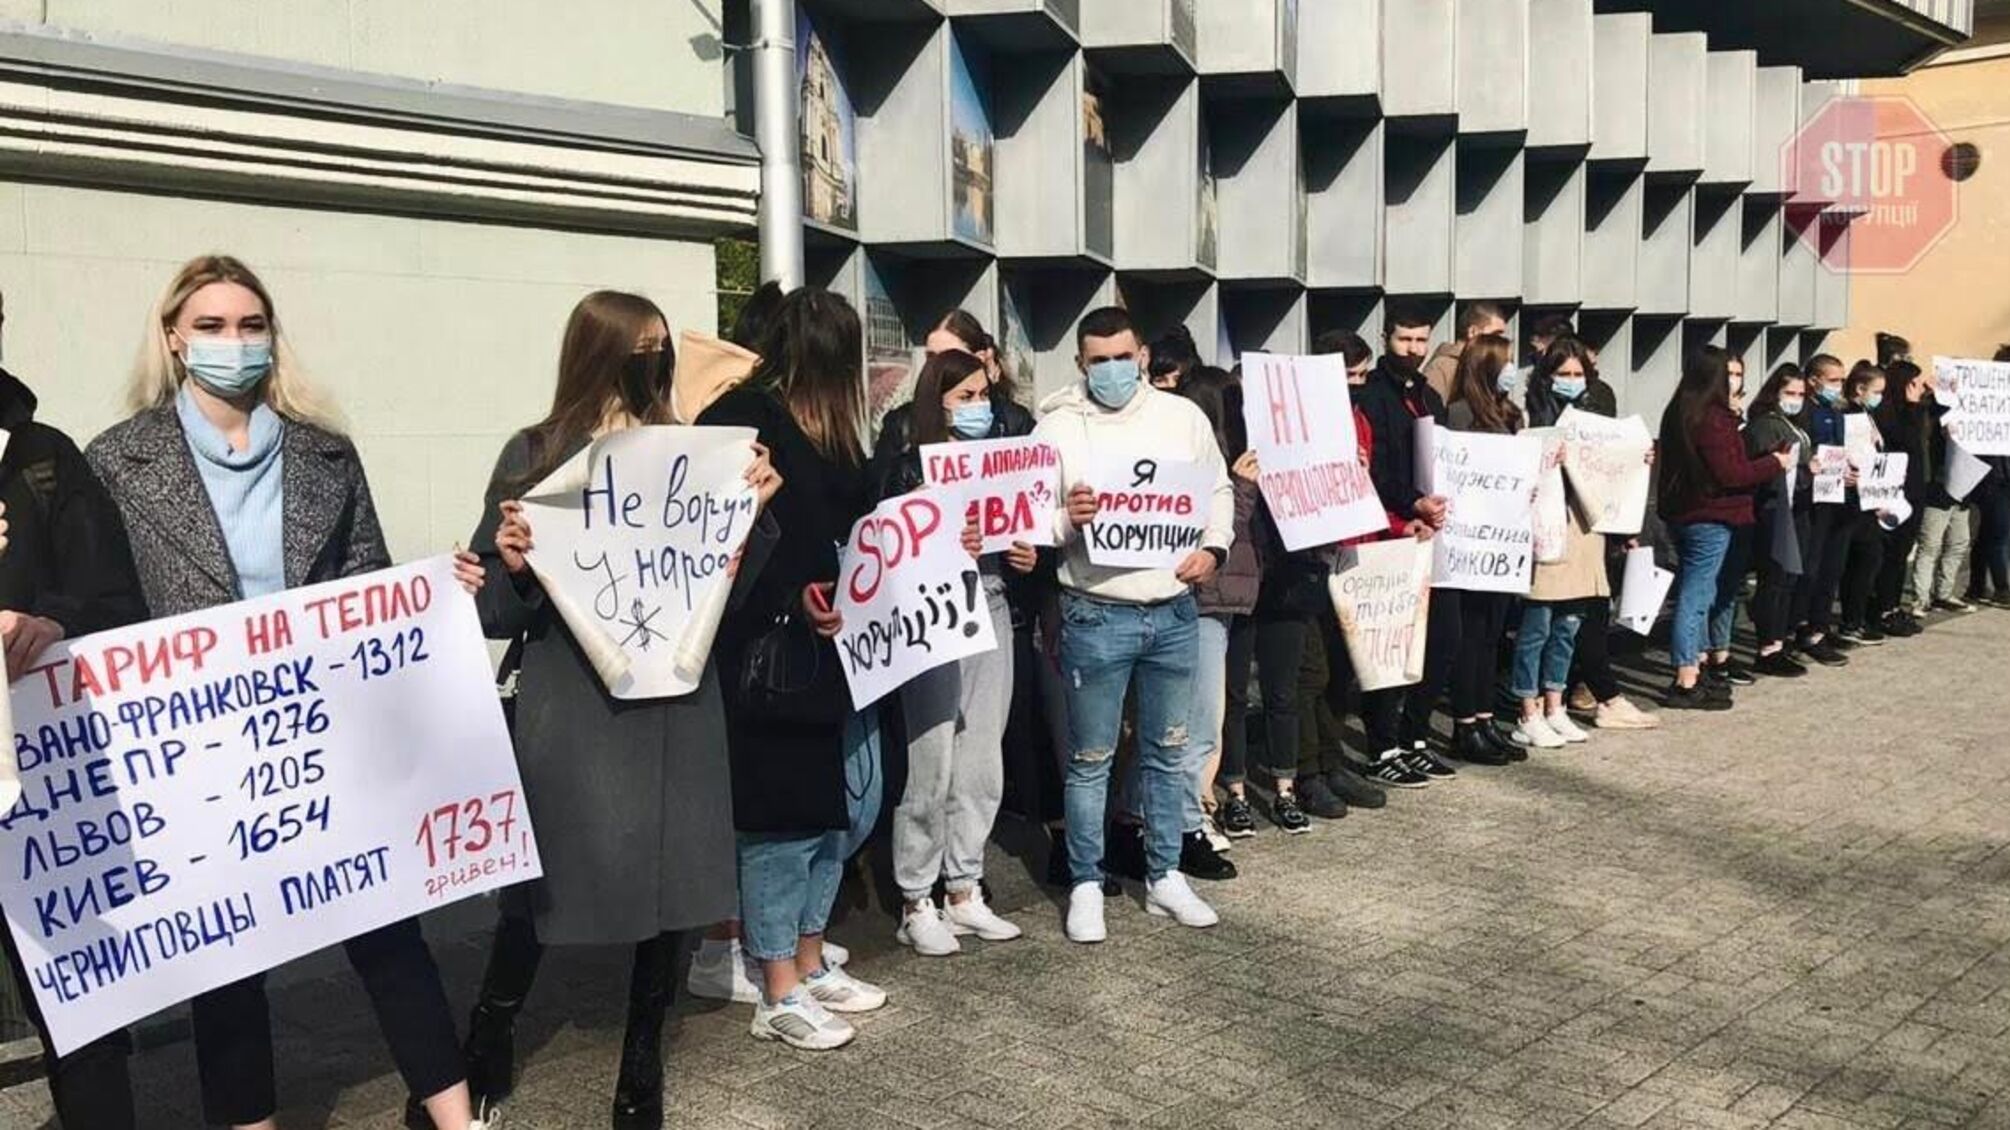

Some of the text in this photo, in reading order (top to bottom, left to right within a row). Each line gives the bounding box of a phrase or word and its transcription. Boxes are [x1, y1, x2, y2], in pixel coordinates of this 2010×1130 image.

[583, 454, 645, 530] Не
[929, 454, 973, 484] ГДЕ
[1098, 492, 1192, 515] ПРОТИВ
[1130, 459, 1157, 488] Я
[1090, 522, 1204, 553] КОРУПЦИИ
[635, 546, 727, 611] наро
[26, 575, 432, 709] ТАРИФ НА ТЕПЛО
[242, 698, 329, 752] 1276
[23, 802, 166, 880] ЛЬВОВ
[240, 749, 325, 801] 1205
[415, 790, 516, 868] 1737
[35, 859, 170, 937] КИЕВ
[227, 795, 331, 861] 1654
[36, 847, 389, 1003] ЧЕРНИГОВЦЫ ПЛАТЯТ
